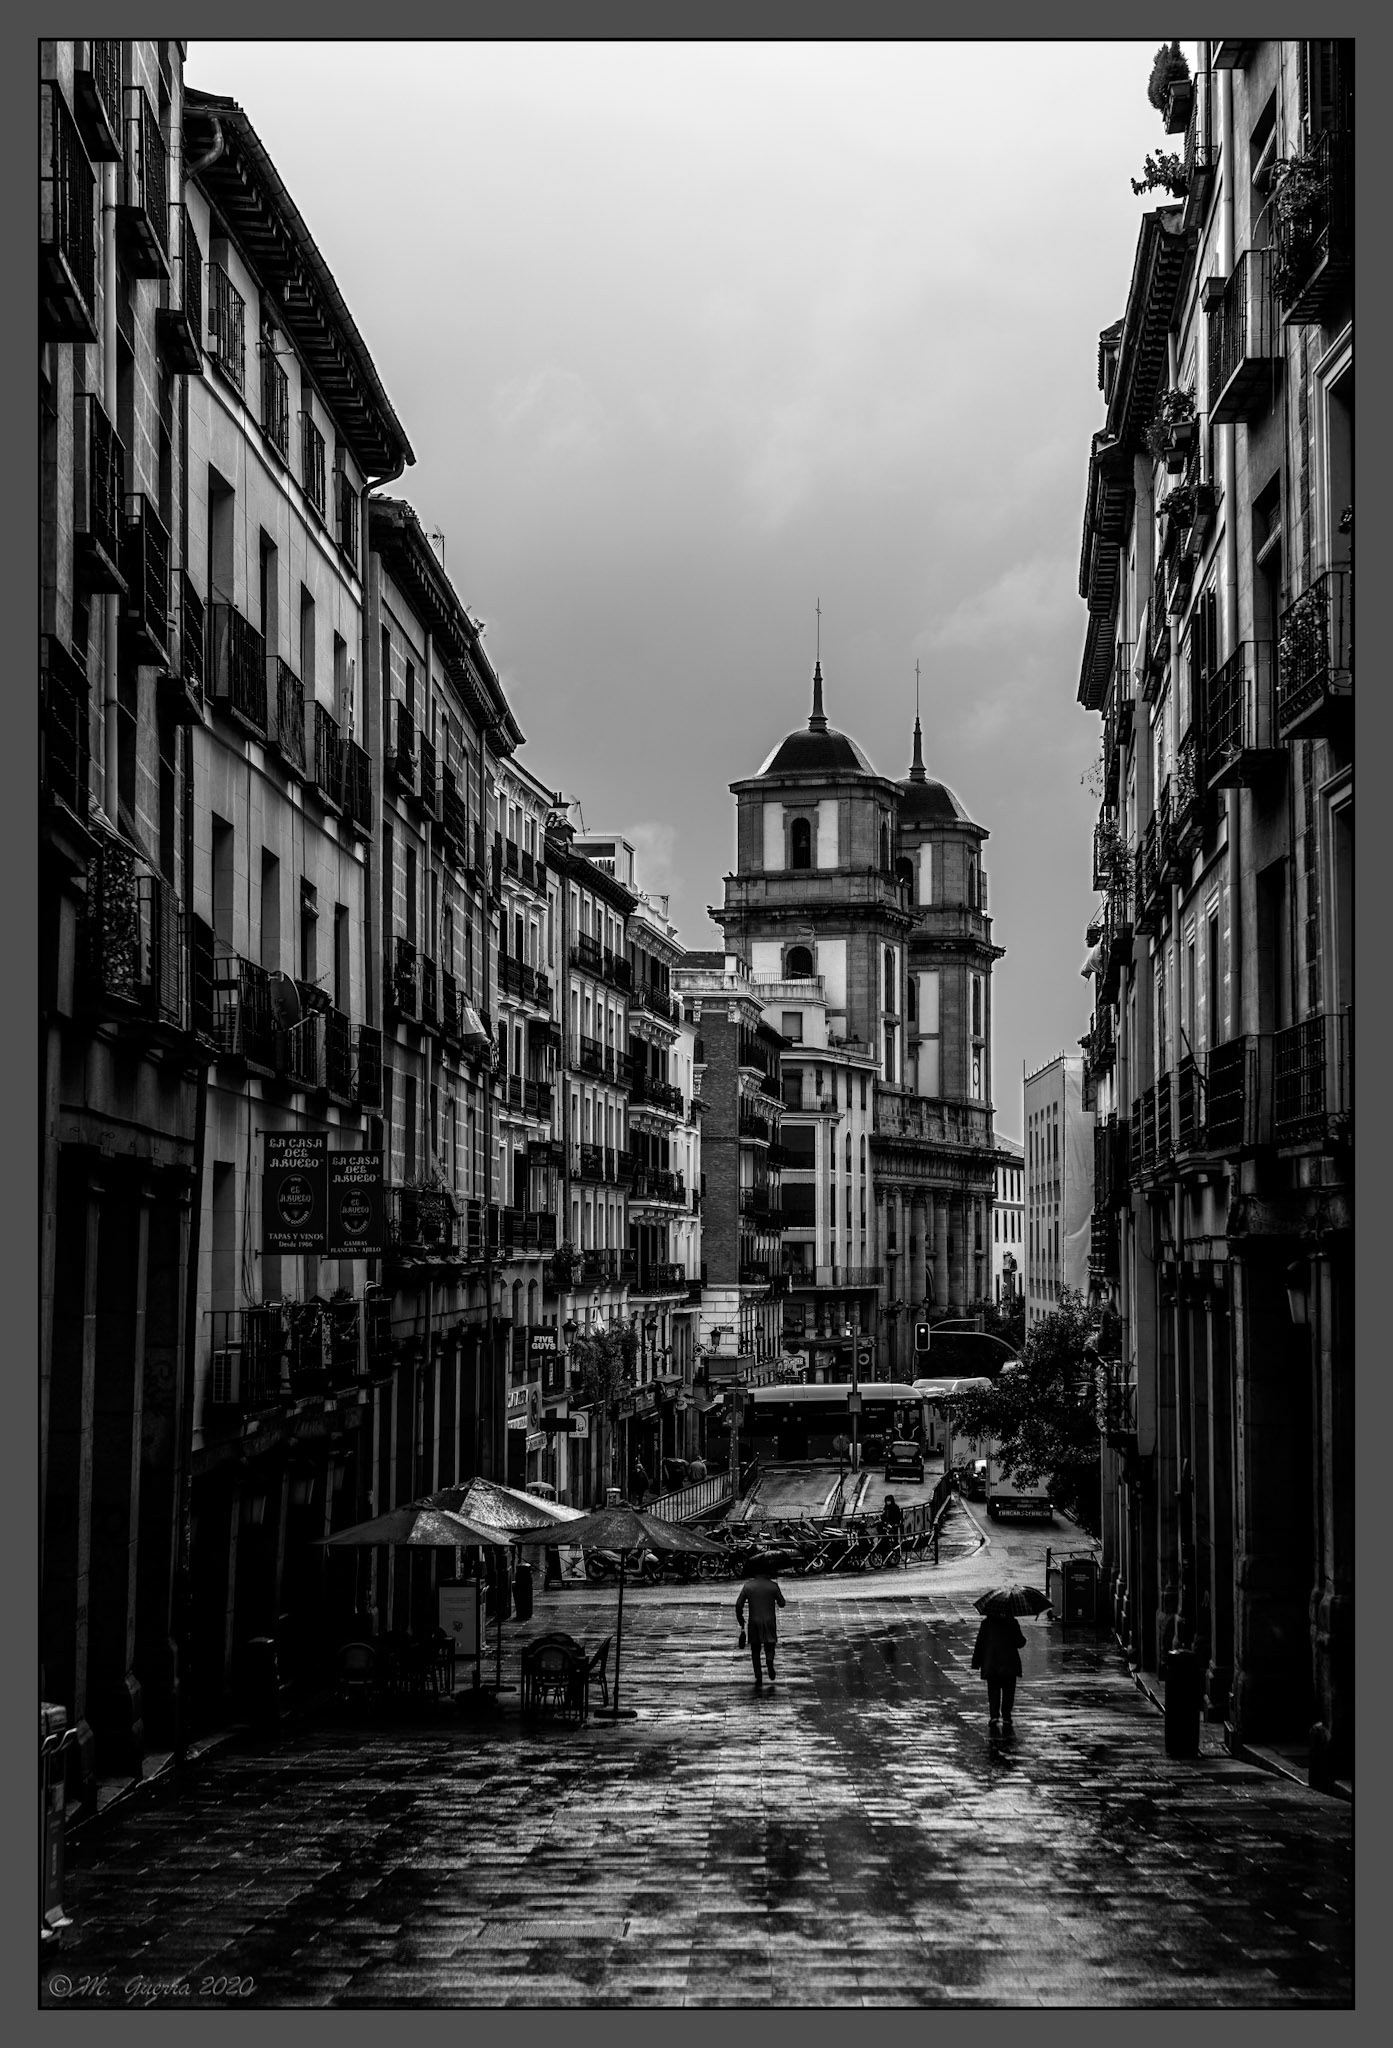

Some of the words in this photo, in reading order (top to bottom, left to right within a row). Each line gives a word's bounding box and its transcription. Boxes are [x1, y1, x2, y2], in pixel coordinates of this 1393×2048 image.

[269, 1138, 286, 1148] LA
[288, 1138, 323, 1148] CASA
[284, 1148, 309, 1157] DEL
[270, 1158, 319, 1168] ABUELO
[332, 1156, 347, 1165] LA
[348, 1156, 379, 1165] CASA
[345, 1165, 367, 1174] DEL
[333, 1174, 376, 1183] ABUELO
[280, 1194, 311, 1203] ABUELO
[269, 1232, 291, 1241] TAPAS
[292, 1232, 299, 1241] Y
[300, 1232, 324, 1241] VINOS
